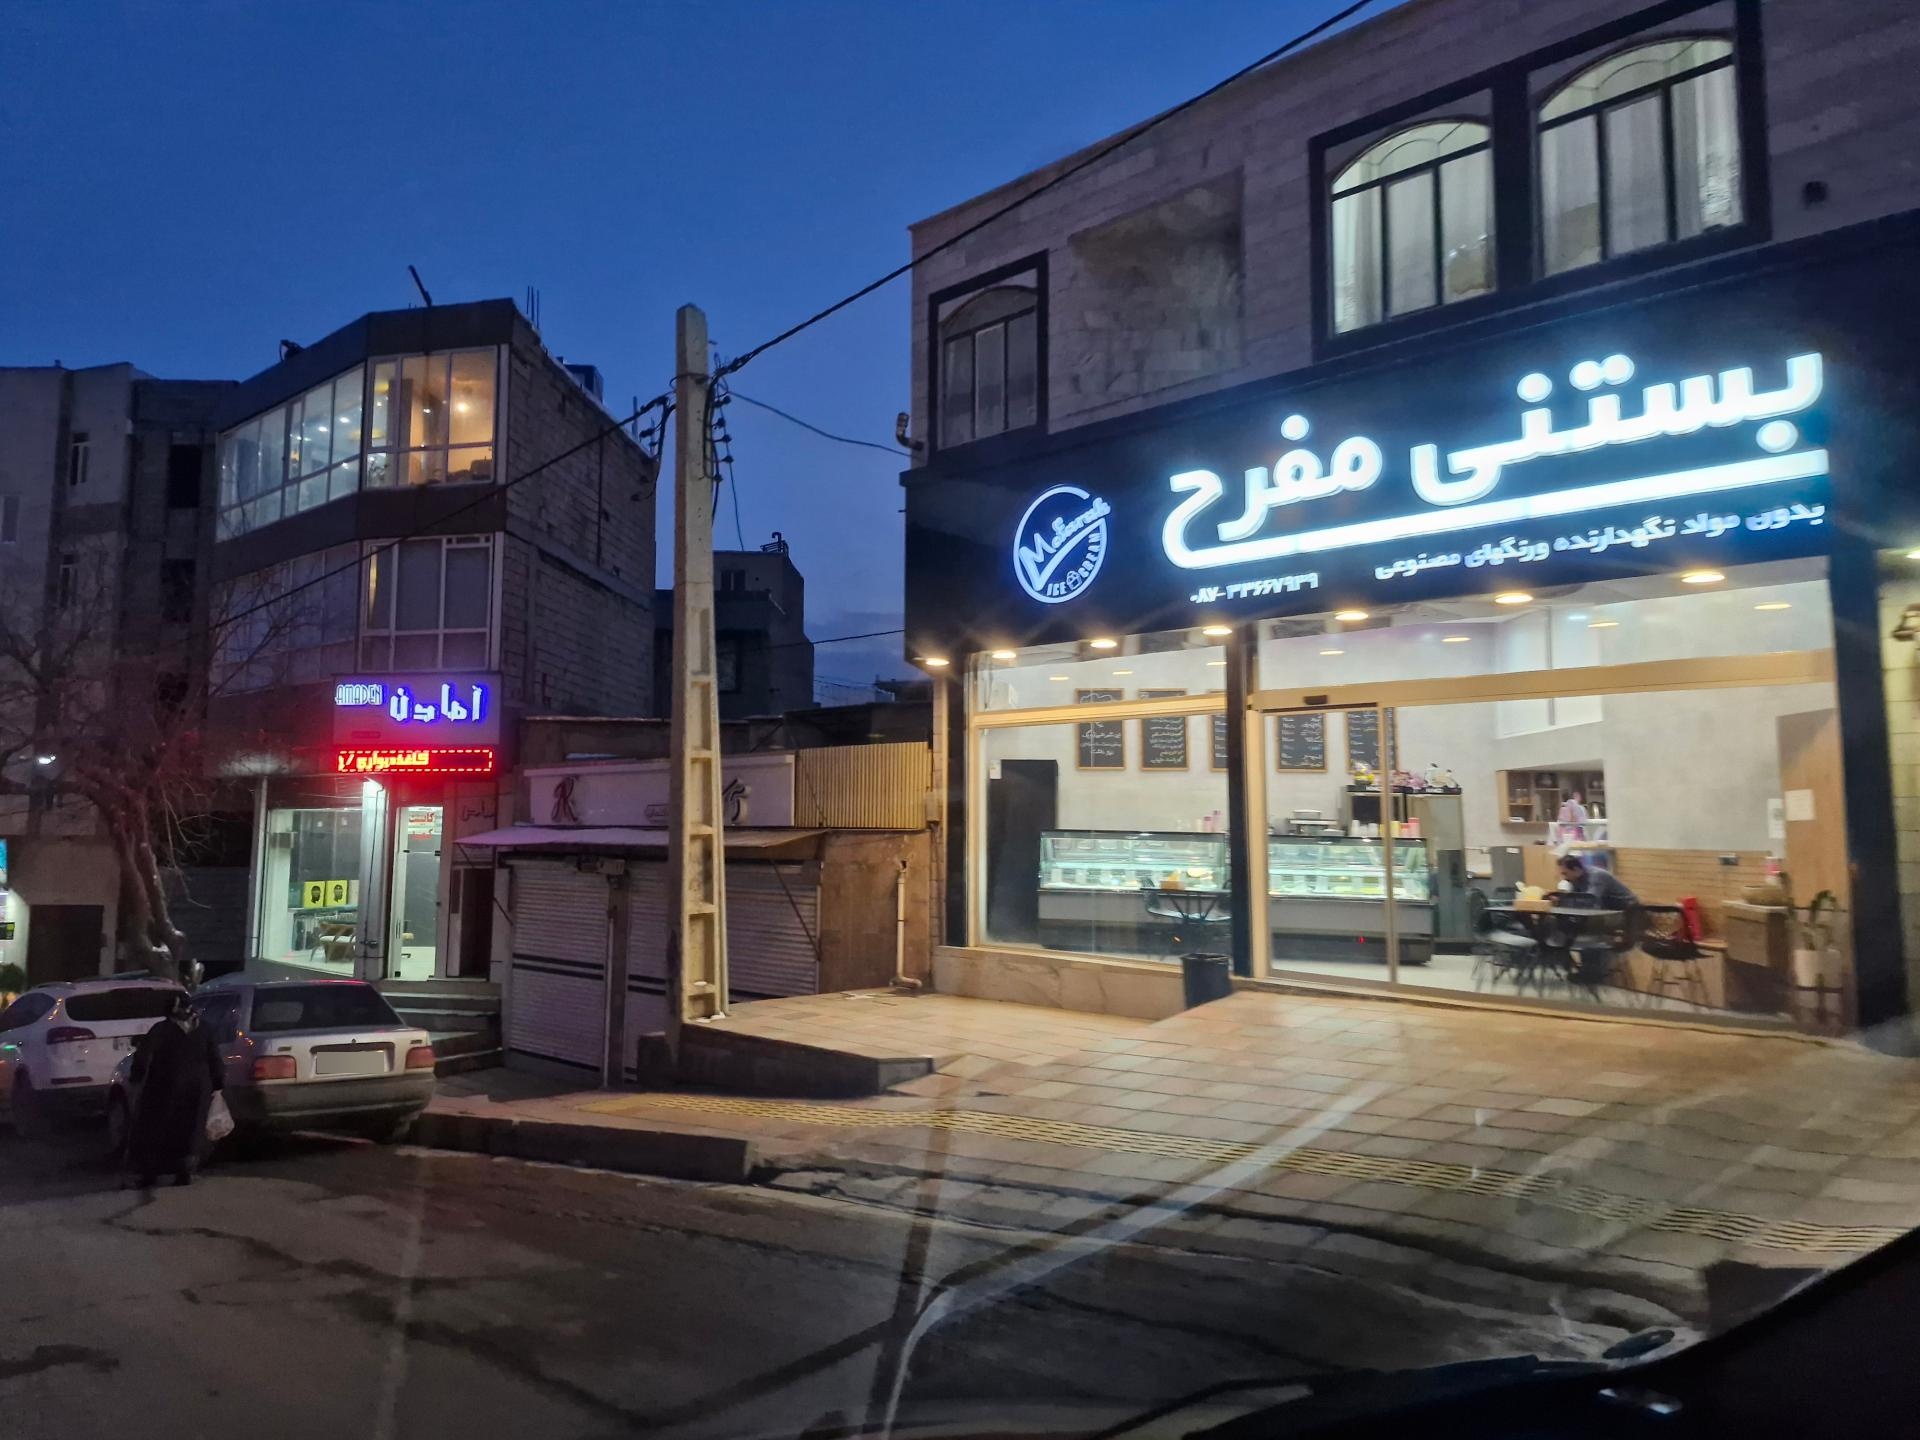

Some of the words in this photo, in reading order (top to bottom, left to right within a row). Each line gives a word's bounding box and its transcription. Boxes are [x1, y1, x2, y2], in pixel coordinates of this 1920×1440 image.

[1410, 353, 1823, 506] بستنی
[1680, 513, 1740, 537] مواد
[1745, 503, 1826, 531] بدون
[1553, 515, 1676, 553] نگهدارنده
[1046, 582, 1068, 596] ICE
[1078, 532, 1102, 578] CREAM
[1374, 553, 1462, 580] مصنوعی
[335, 684, 383, 705] AMADEN
[389, 684, 482, 722] آمادن
